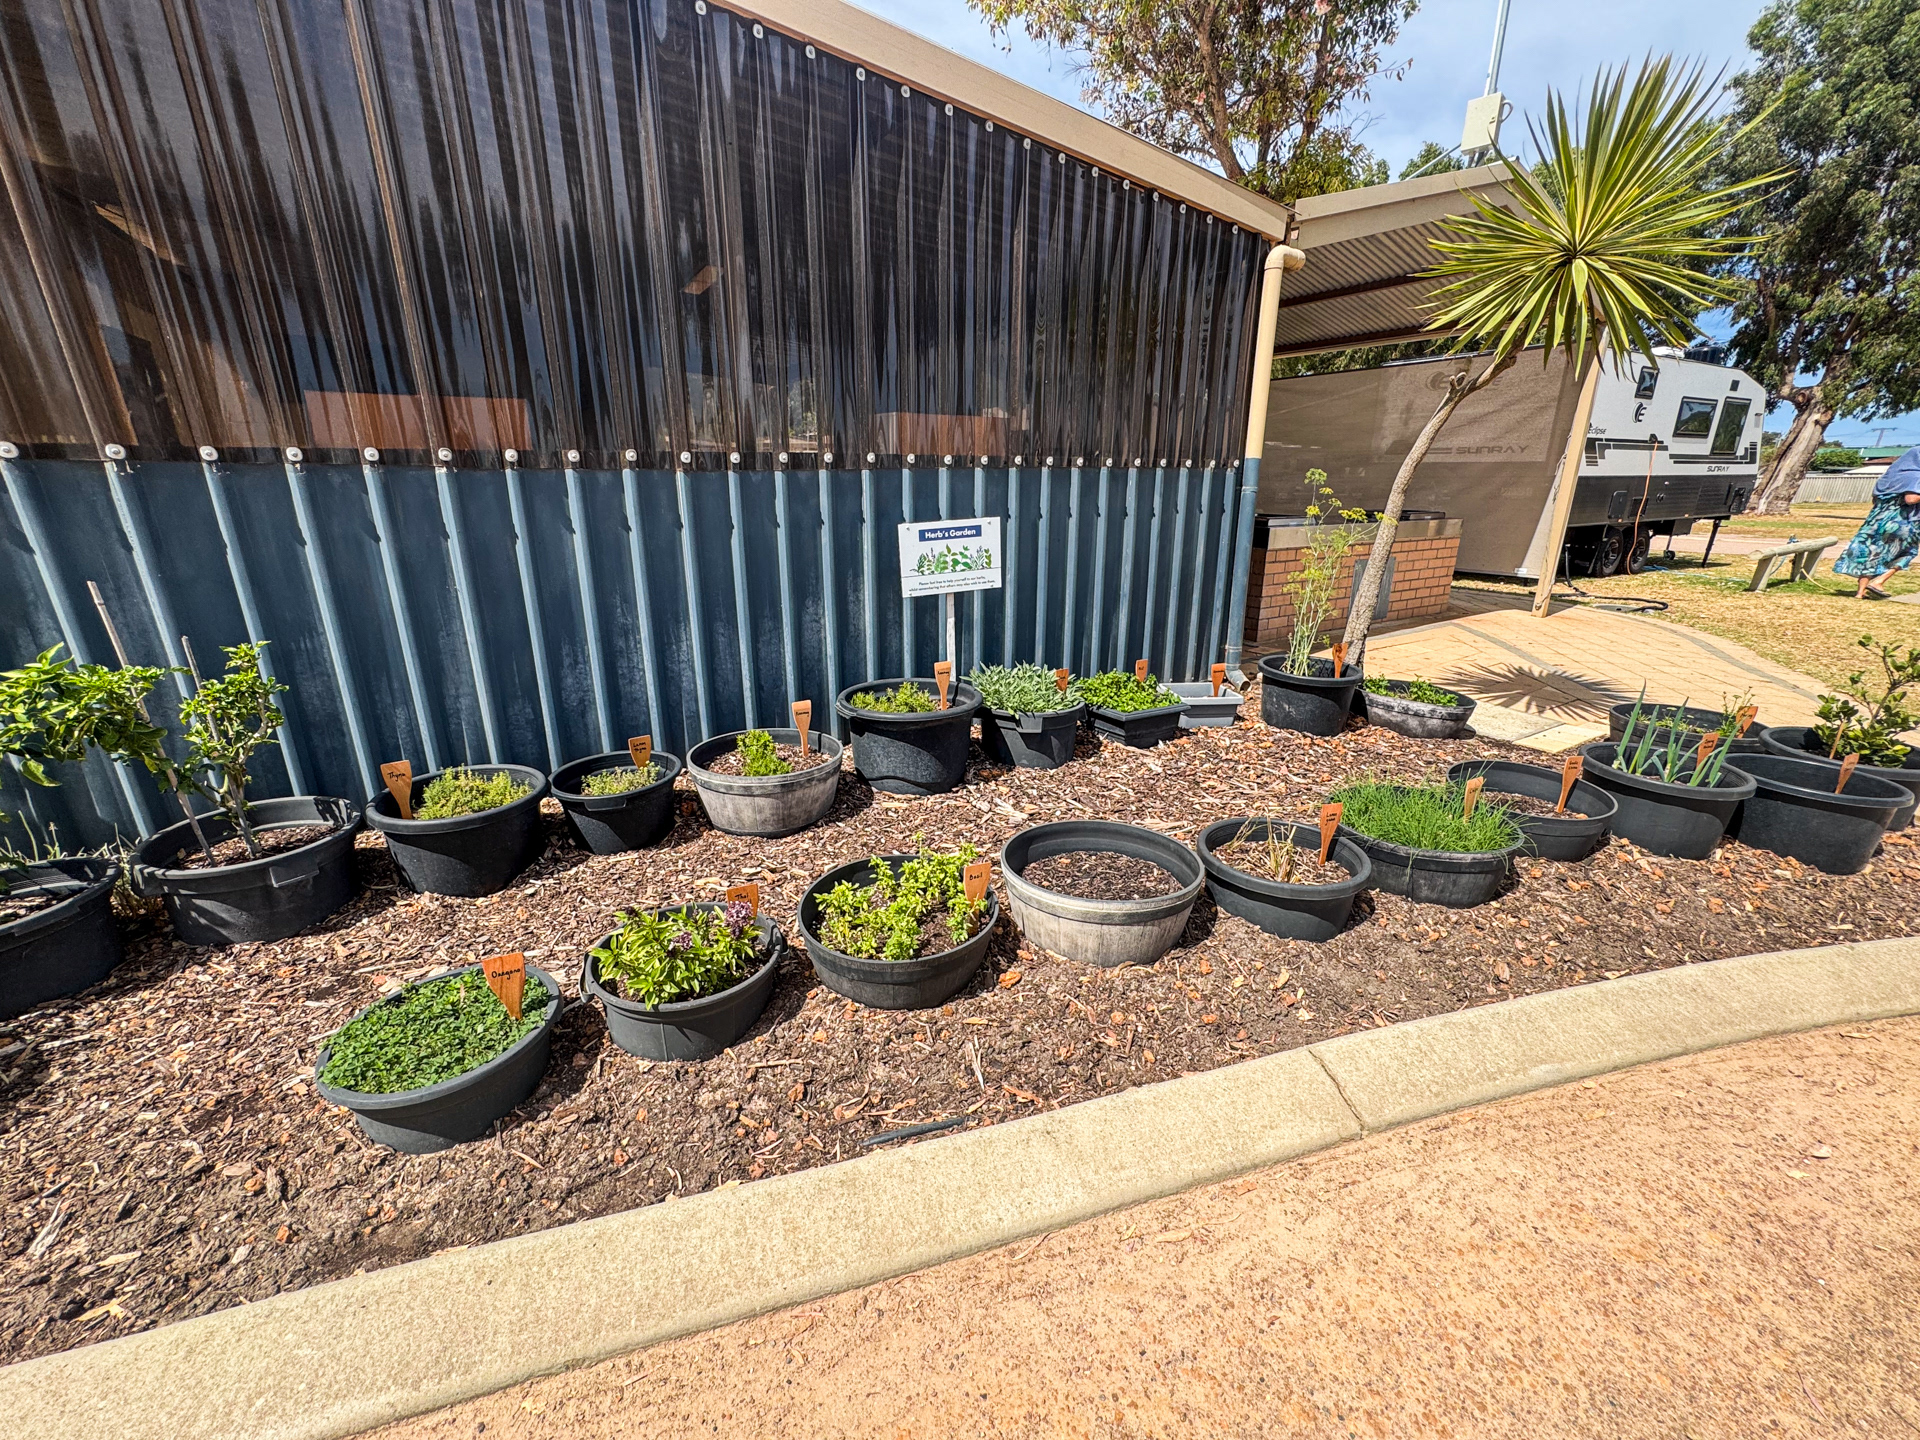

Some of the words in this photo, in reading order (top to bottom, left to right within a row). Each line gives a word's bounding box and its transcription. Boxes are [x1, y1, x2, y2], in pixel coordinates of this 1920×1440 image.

[1456, 445, 1529, 454] SUNRAY
[1706, 465, 1730, 473] SUNRAY
[925, 530, 949, 539] Herb's
[949, 528, 976, 537] Garden
[387, 772, 406, 781] Thyme
[969, 871, 983, 881] Basil
[491, 967, 521, 980] Oregano
